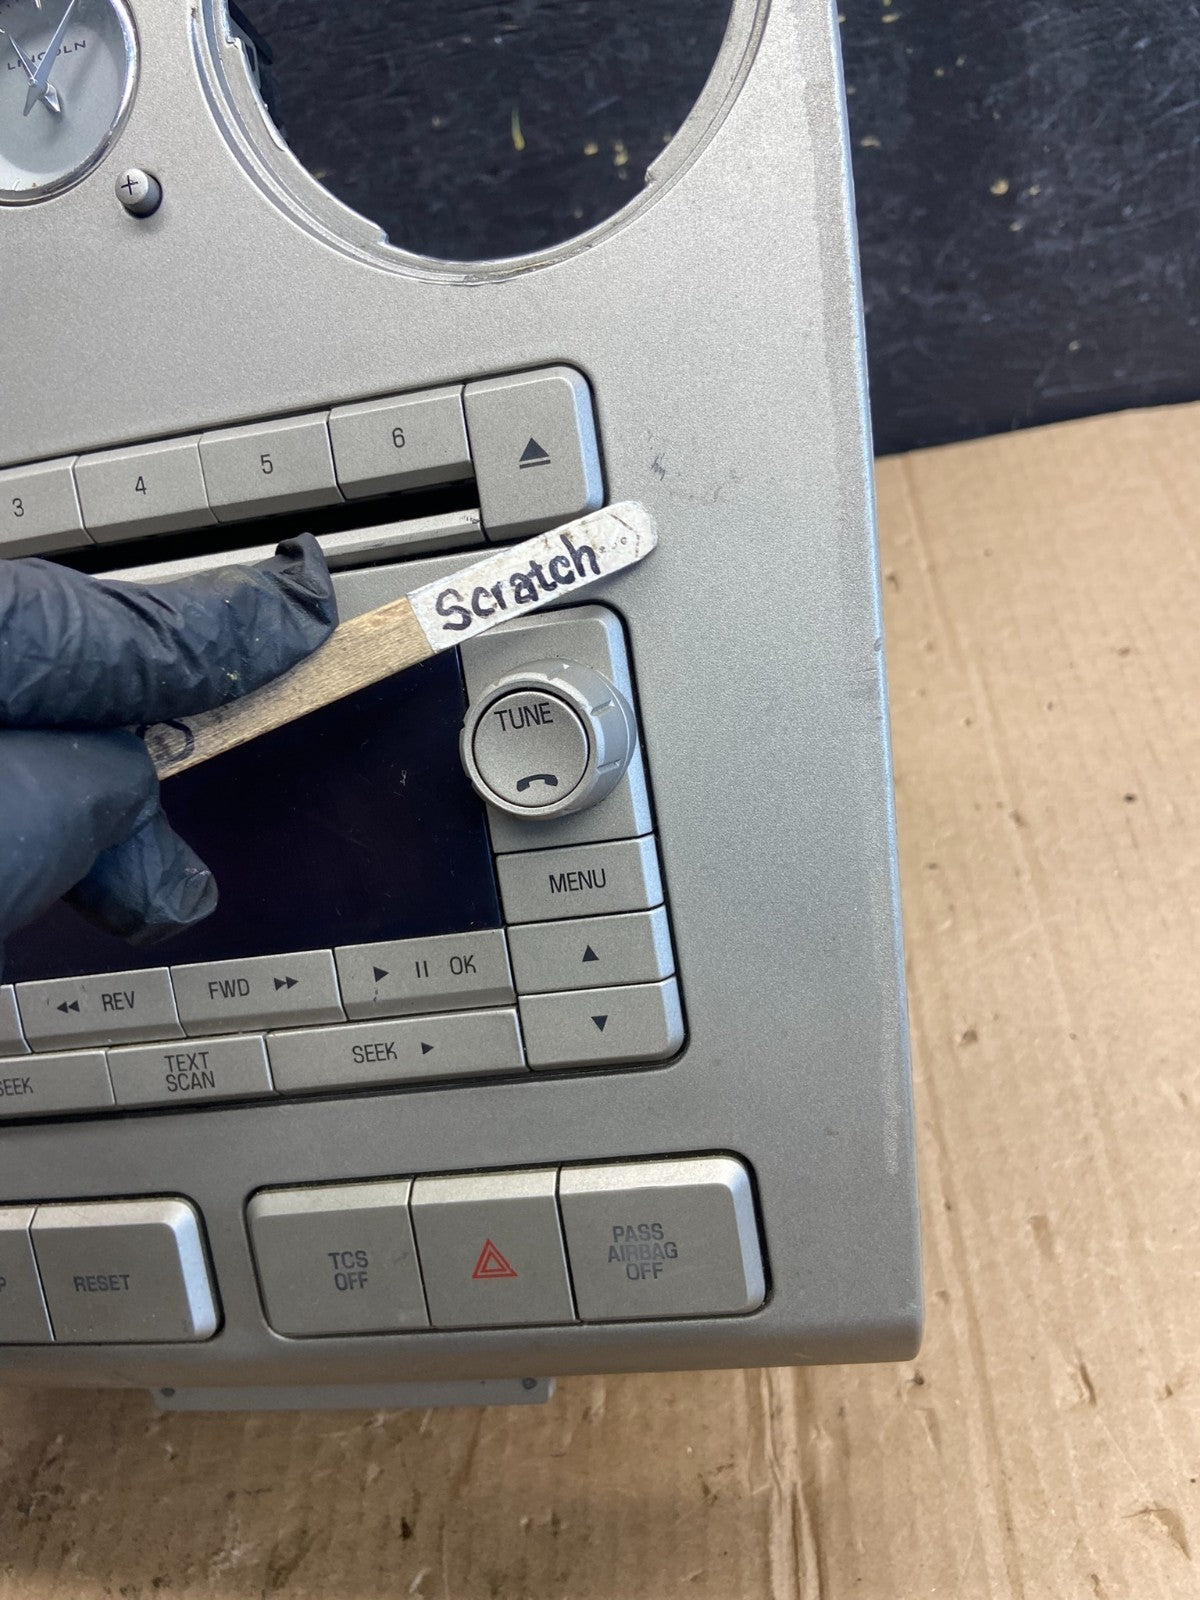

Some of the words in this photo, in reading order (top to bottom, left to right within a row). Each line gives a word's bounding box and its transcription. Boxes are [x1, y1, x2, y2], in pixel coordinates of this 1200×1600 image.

[391, 426, 406, 449] 6
[260, 454, 274, 475] 5
[134, 475, 148, 495] 4
[11, 498, 24, 518] 3
[434, 533, 601, 632] Scratch
[494, 702, 554, 732] TUNE
[548, 868, 607, 894] MENU
[450, 955, 477, 976] OK
[207, 978, 250, 1000] FWD
[101, 990, 136, 1012] REV
[164, 1051, 210, 1073] TEXT
[351, 1041, 398, 1064] SEEK
[165, 1071, 216, 1092] SCAN
[612, 1222, 665, 1243] PASS
[328, 1250, 369, 1270] TCS
[607, 1242, 678, 1264] AIRBAG
[334, 1271, 369, 1292] OFF
[625, 1262, 664, 1281] OFF
[73, 1274, 131, 1293] RESET
